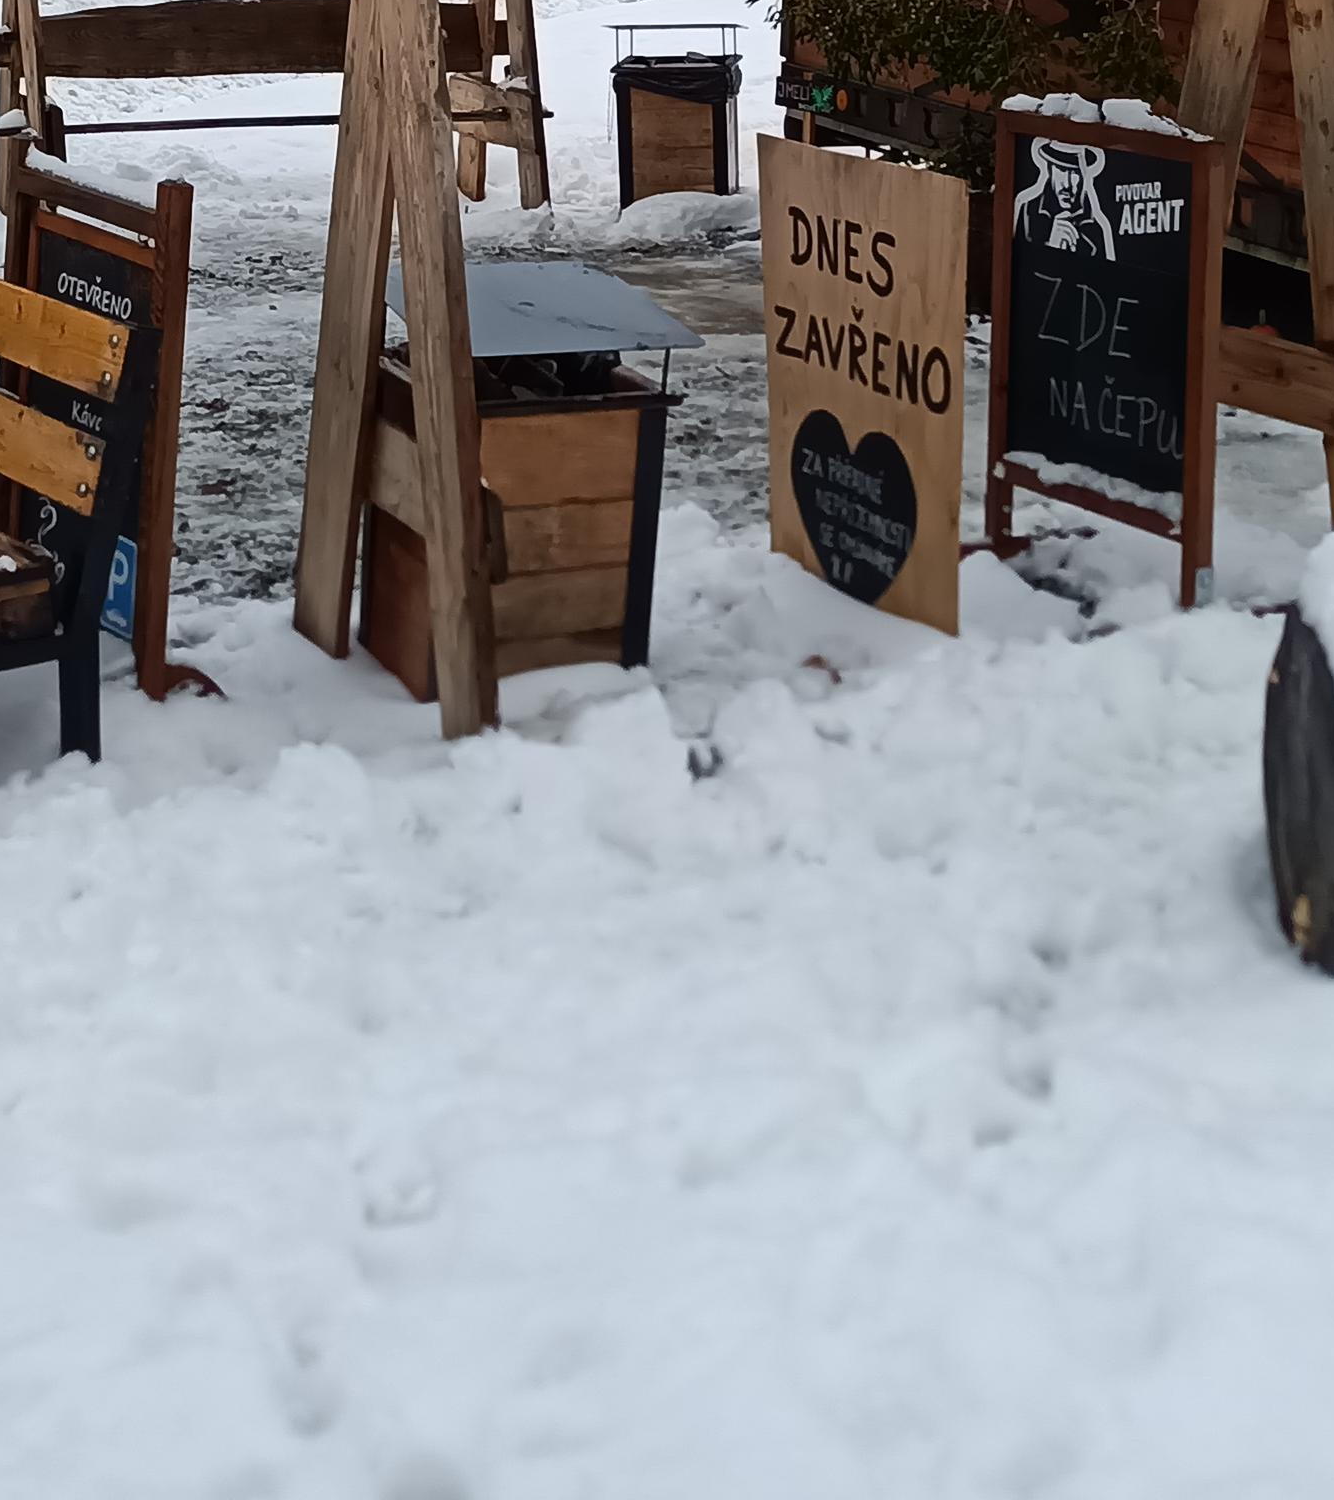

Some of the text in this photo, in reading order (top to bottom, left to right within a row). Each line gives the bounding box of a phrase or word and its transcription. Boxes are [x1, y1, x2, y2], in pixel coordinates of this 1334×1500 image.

[1115, 181, 1161, 201] PIVOVAR
[1119, 199, 1185, 236] AGENT
[788, 206, 897, 298] DNES
[57, 272, 132, 320] OTEVŘENO
[1034, 271, 1140, 359] ZDE
[773, 297, 952, 415] ZAVŘENO
[1048, 376, 1184, 461] NA ČEPU
[107, 548, 129, 601] P
